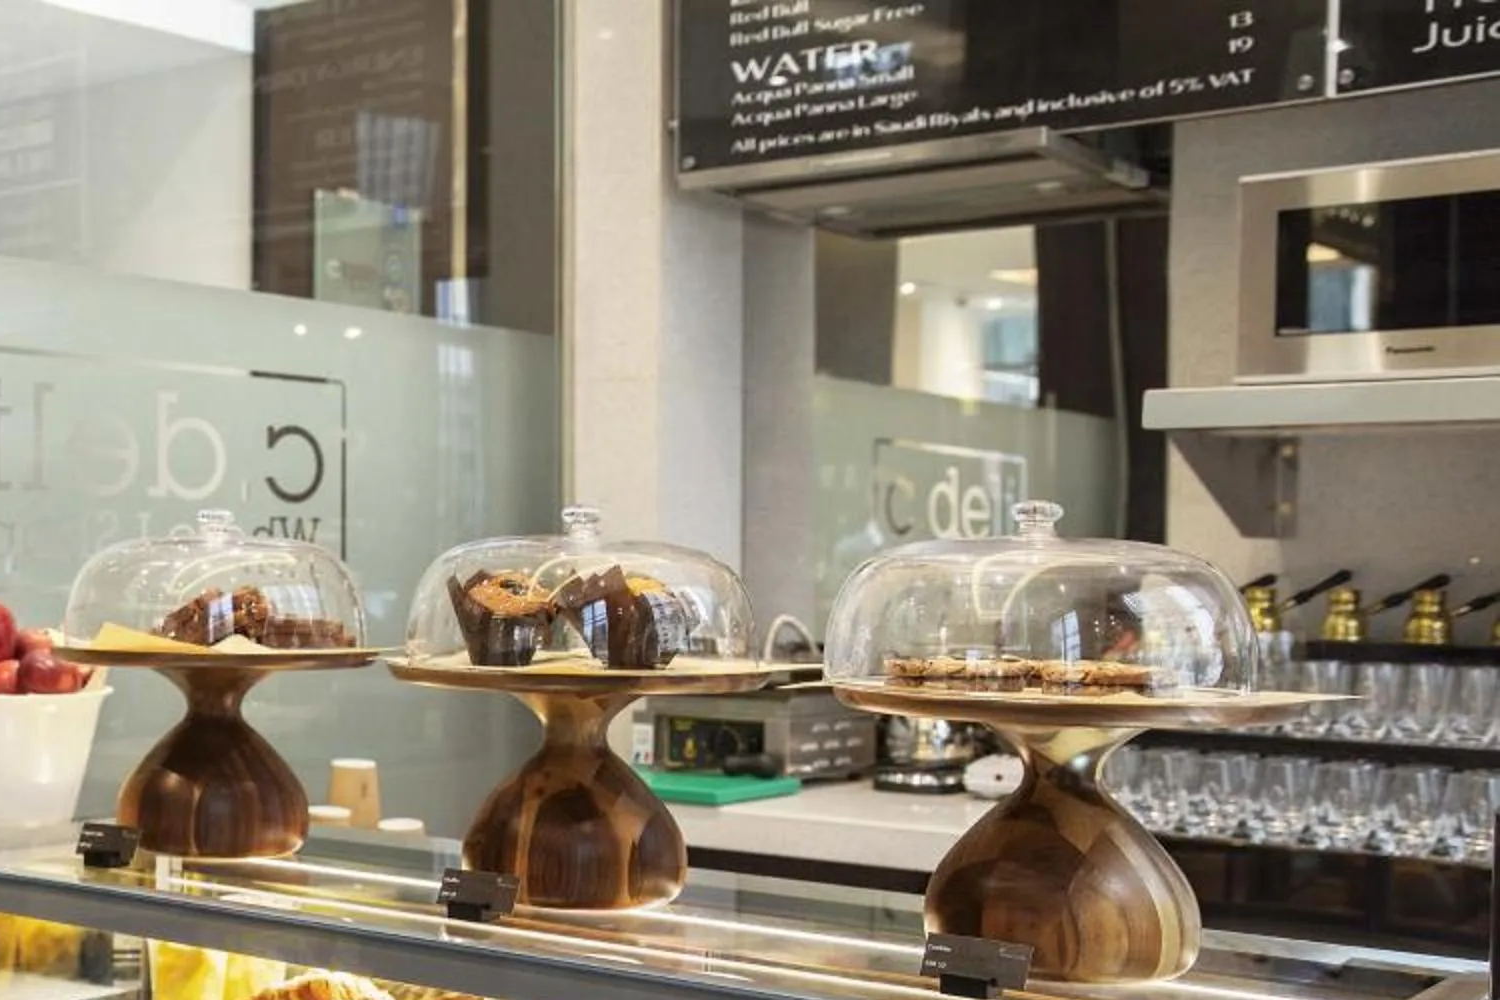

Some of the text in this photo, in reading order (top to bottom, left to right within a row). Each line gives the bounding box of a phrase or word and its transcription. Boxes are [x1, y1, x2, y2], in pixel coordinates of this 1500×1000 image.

[729, 4, 924, 46] Red Bull Sugar Free
[1228, 11, 1255, 29] 13
[730, 39, 878, 83] WATER
[1228, 36, 1255, 54] 19
[731, 65, 915, 106] Acqua Panna Small
[731, 90, 918, 127] Acqua Panna Large
[731, 66, 1256, 155] All prices are in Saudi Riyals and inclusive of 5% VAT
